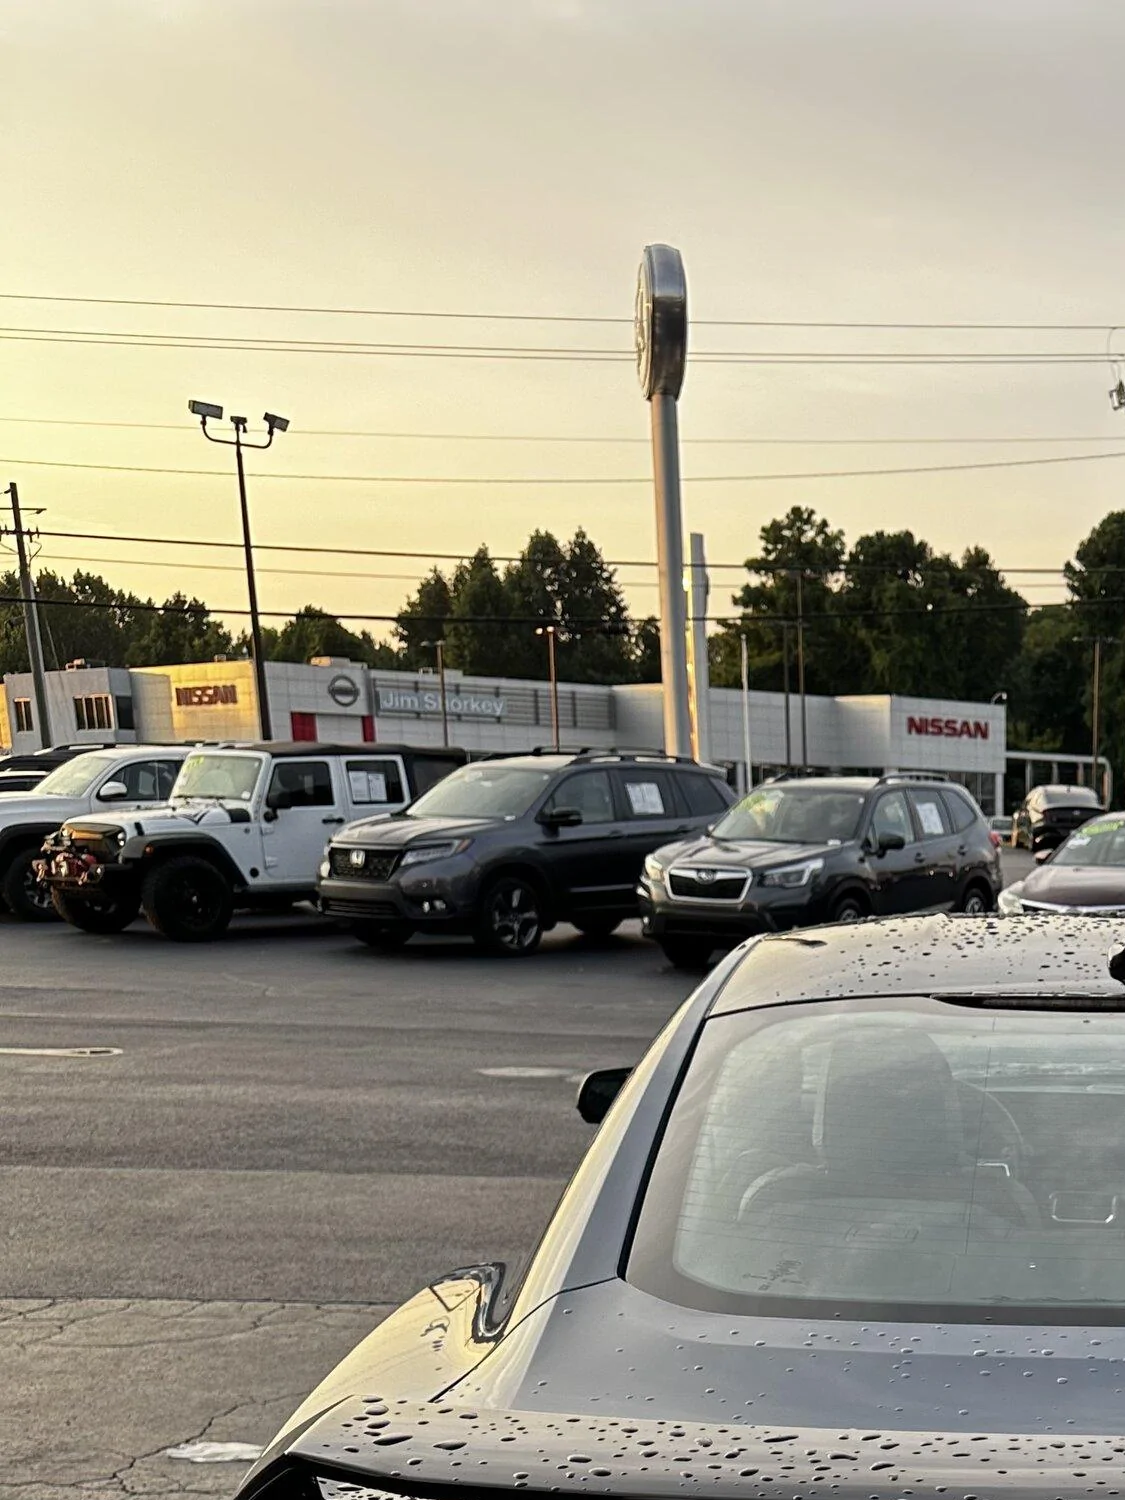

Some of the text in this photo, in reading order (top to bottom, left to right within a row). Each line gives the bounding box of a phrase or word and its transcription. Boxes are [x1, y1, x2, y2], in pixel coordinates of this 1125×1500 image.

[175, 684, 238, 706] NISSAN
[382, 690, 418, 709] Jim
[906, 716, 990, 739] NISSAN
